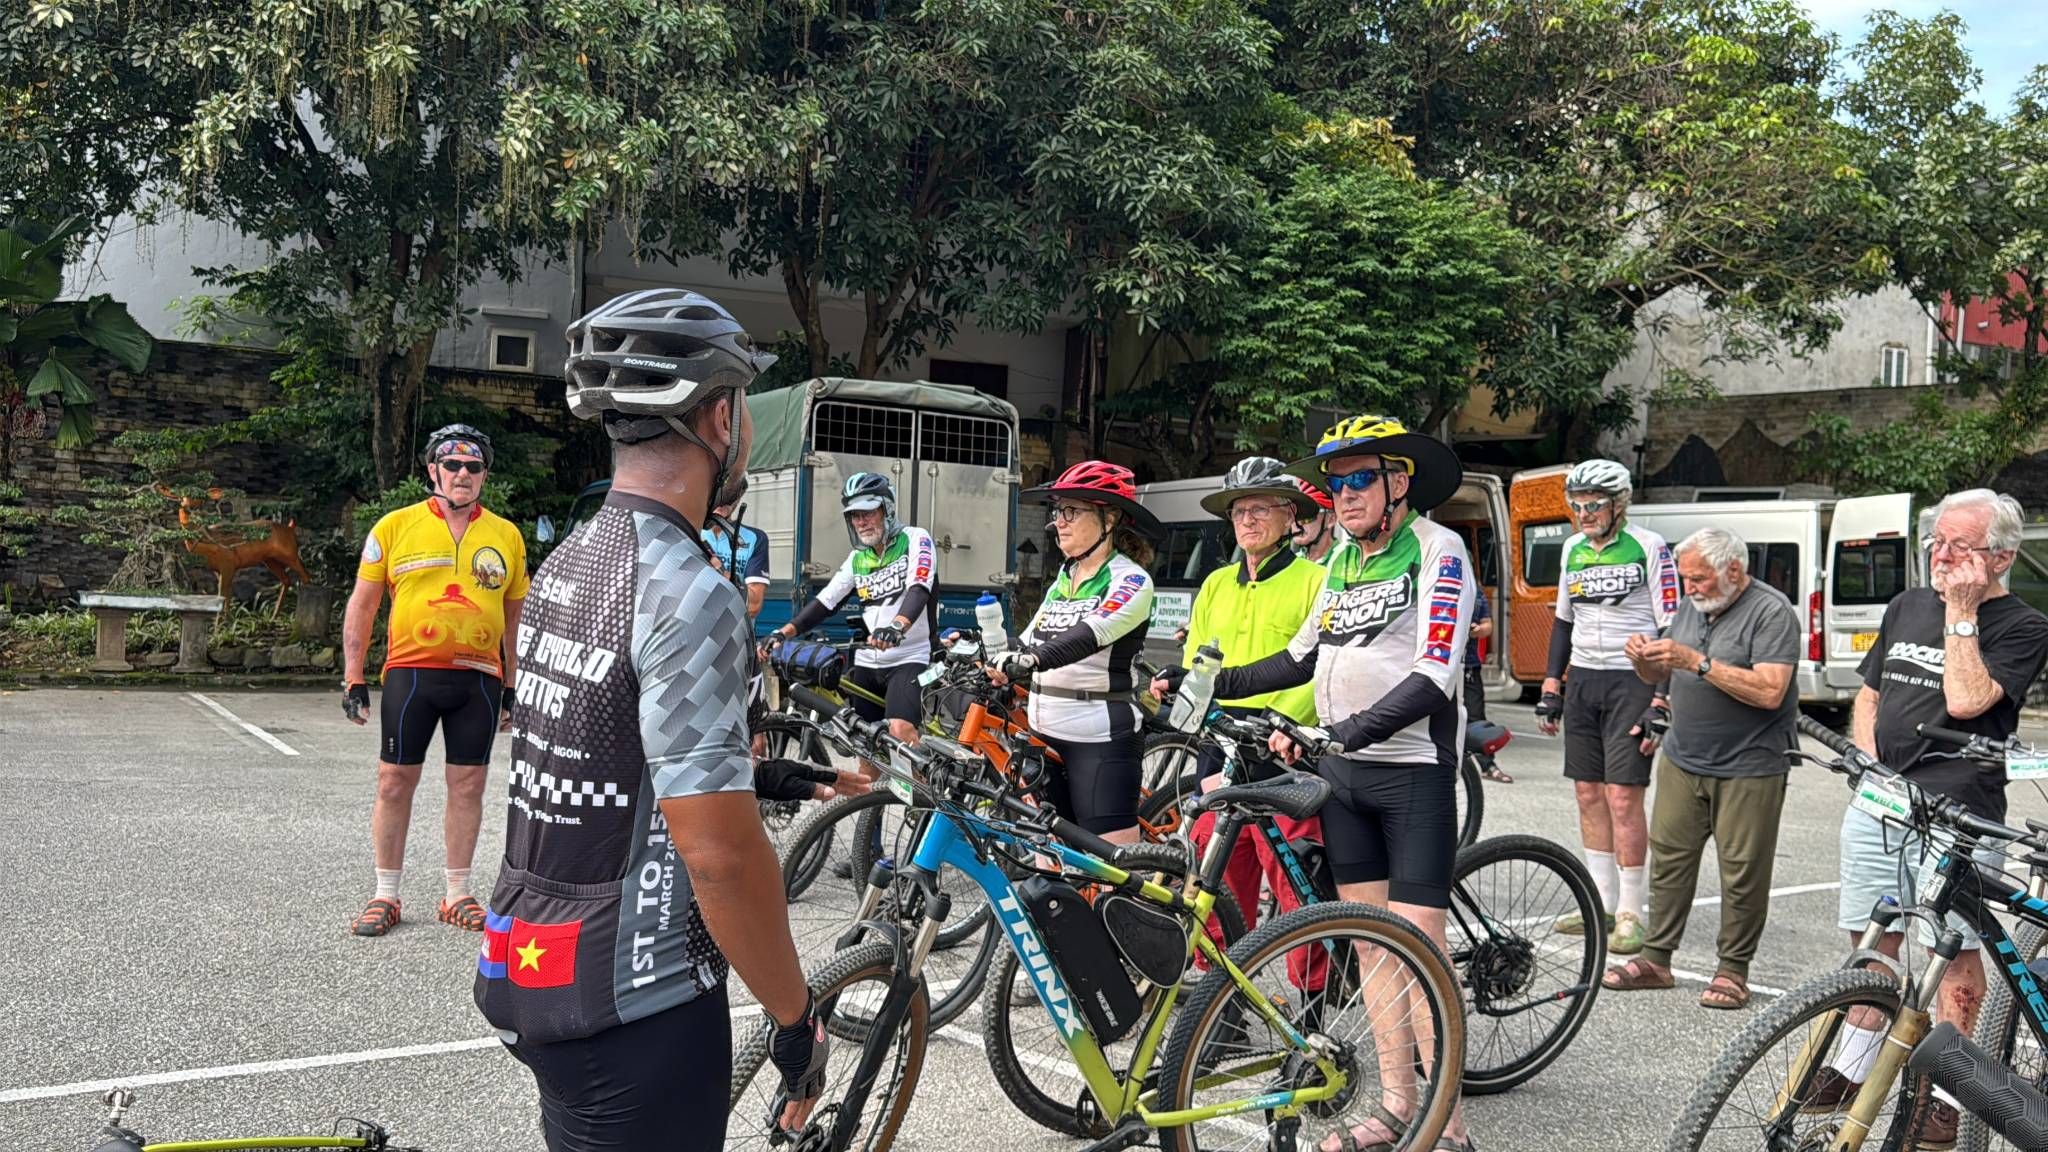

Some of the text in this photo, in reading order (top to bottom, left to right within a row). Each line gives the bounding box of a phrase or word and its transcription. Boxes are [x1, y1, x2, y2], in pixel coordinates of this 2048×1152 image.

[624, 357, 678, 370] BONTRAGER
[1587, 578, 1625, 594] NOI
[945, 606, 976, 616] FRONT
[1157, 607, 1189, 617] ADVENTURE
[1158, 596, 1182, 605] VIETNAM
[1337, 599, 1386, 629] NOI
[535, 631, 617, 684] CYCLO
[553, 744, 582, 761] AIGON
[631, 798, 668, 989] 1ST TO 15
[658, 833, 676, 931] MARCH 20
[998, 885, 1085, 1040] TRINX
[1995, 927, 2048, 1035] TRE
